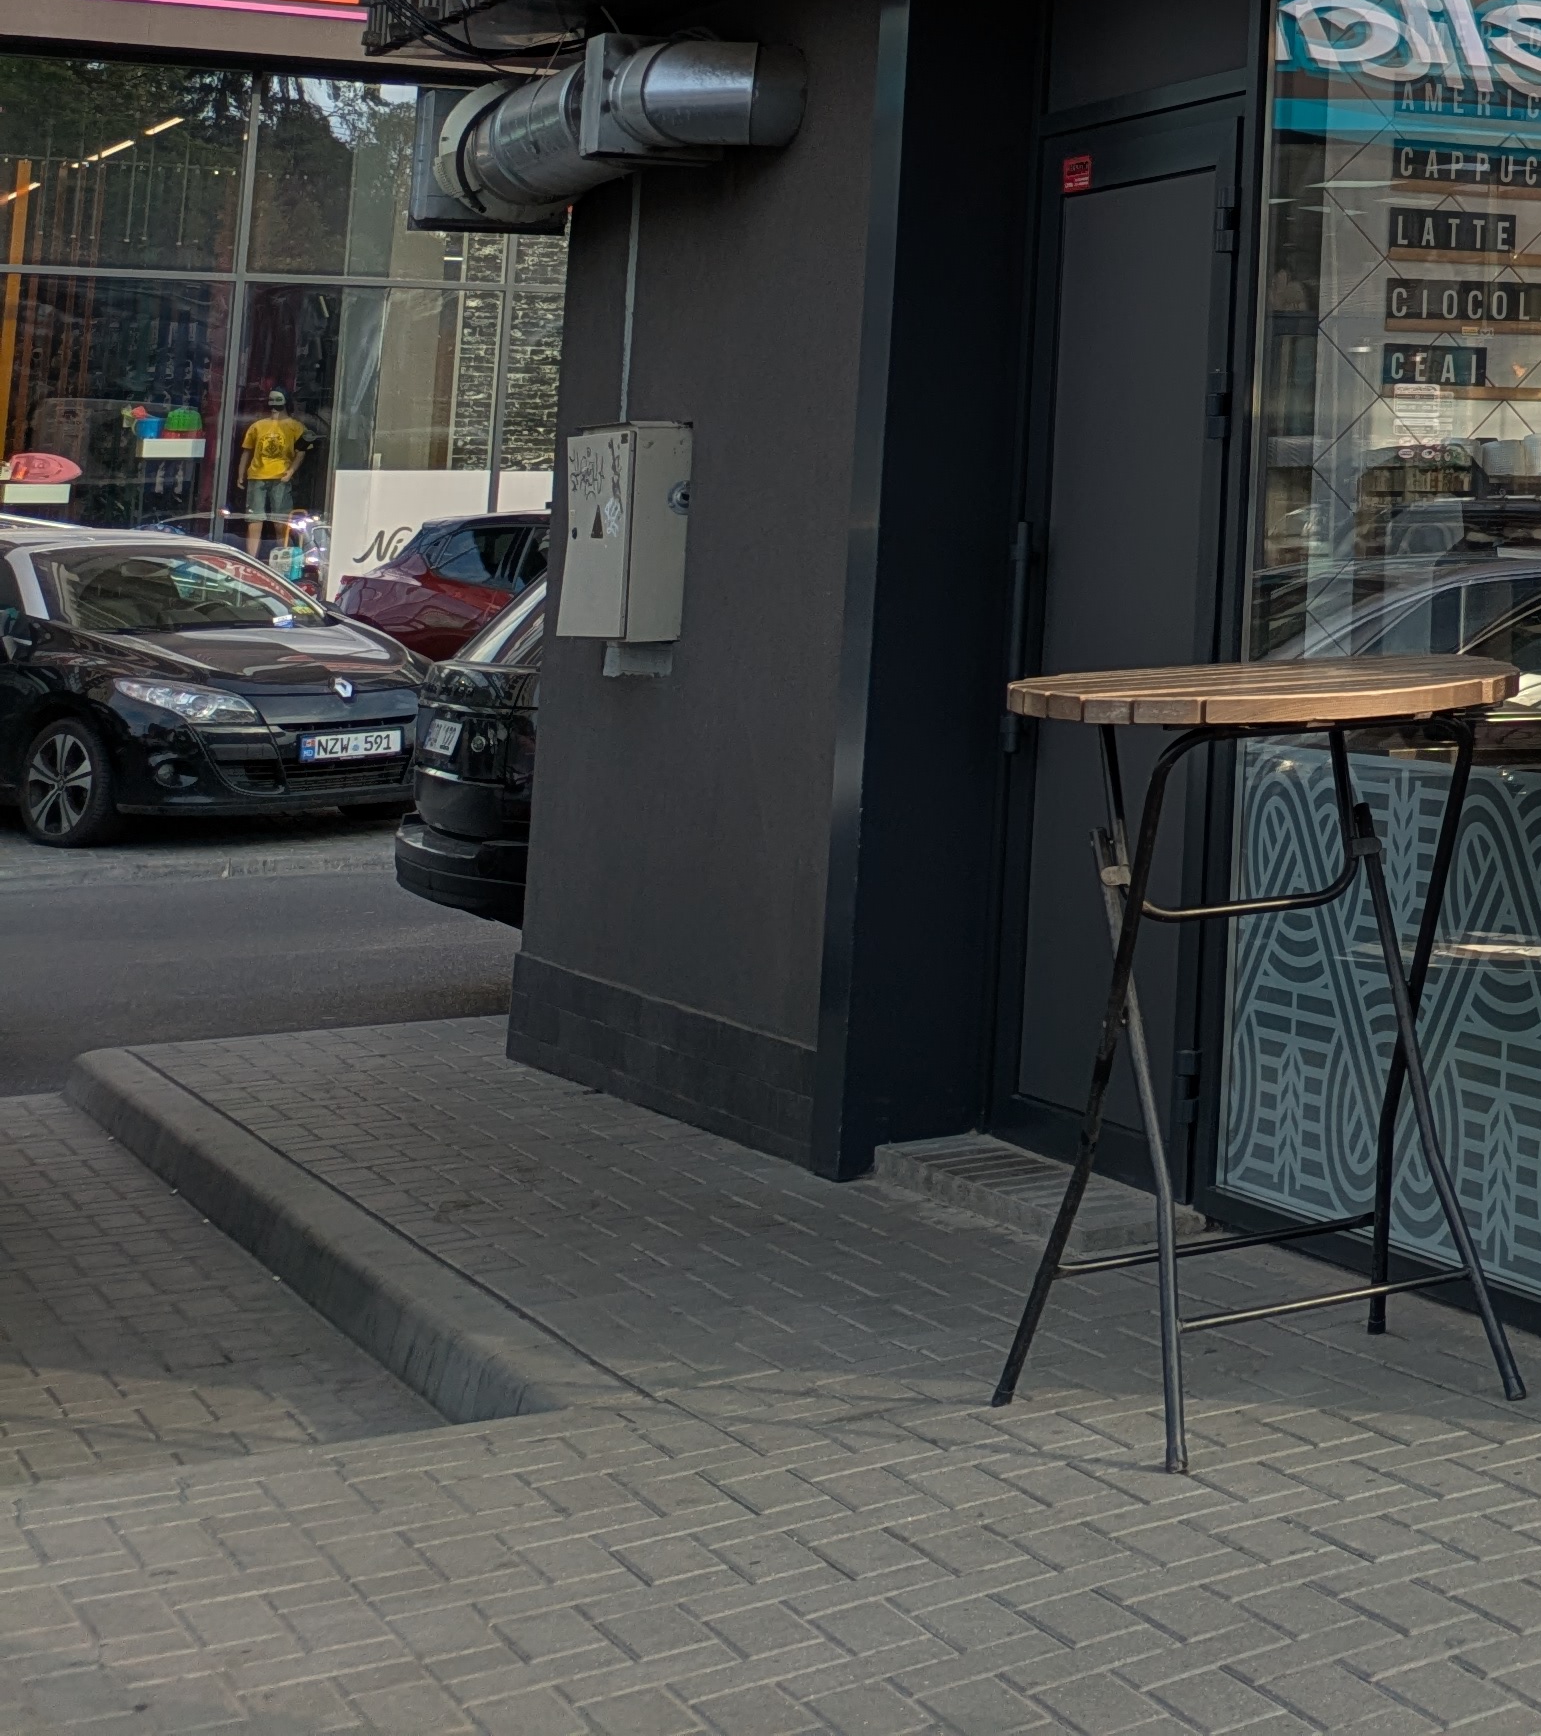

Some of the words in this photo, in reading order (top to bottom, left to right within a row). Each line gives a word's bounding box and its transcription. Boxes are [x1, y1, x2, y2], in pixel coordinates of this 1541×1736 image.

[1396, 217, 1511, 251] LATTE
[1390, 351, 1479, 383] CEAI
[316, 736, 351, 756] NZW
[363, 733, 392, 752] 591
